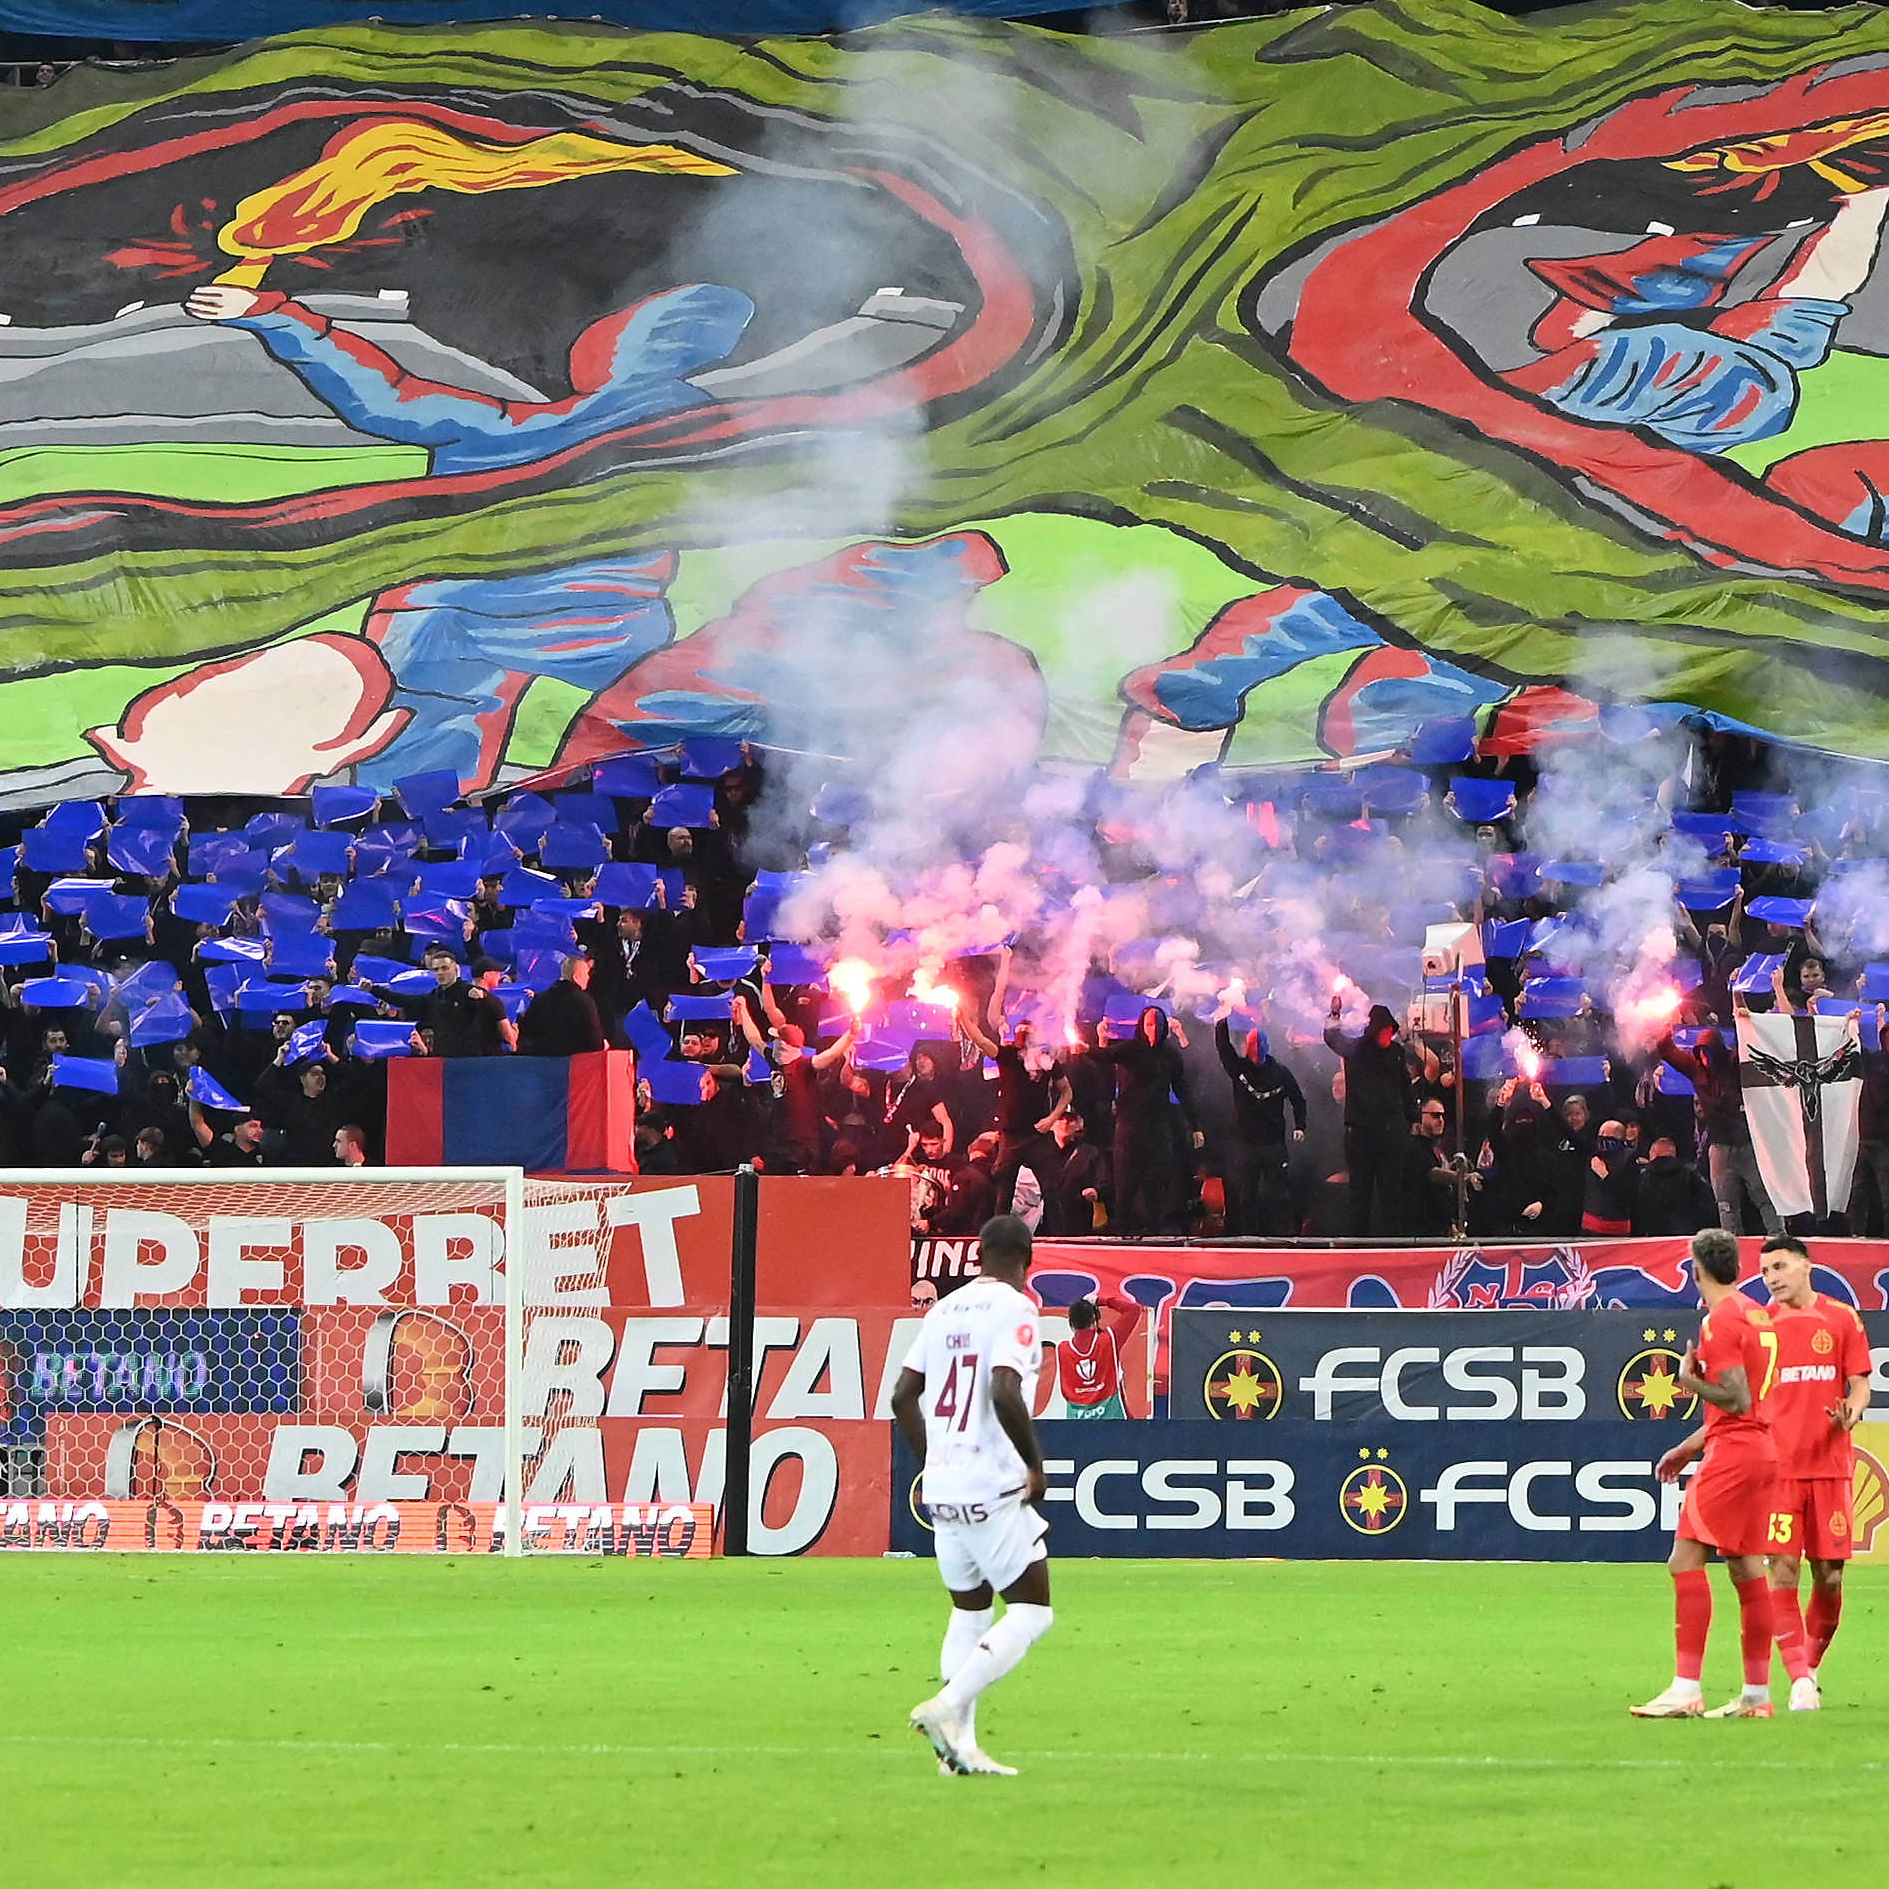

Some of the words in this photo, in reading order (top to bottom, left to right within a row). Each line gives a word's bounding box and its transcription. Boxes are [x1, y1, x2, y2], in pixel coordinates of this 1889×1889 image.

[522, 1317, 1073, 1421] BETA
[935, 1354, 978, 1432] 47
[1300, 1346, 1587, 1421] FCSB
[1759, 1331, 1778, 1401] 7
[1780, 1365, 1837, 1384] BETANO
[199, 1503, 402, 1551] BETANO
